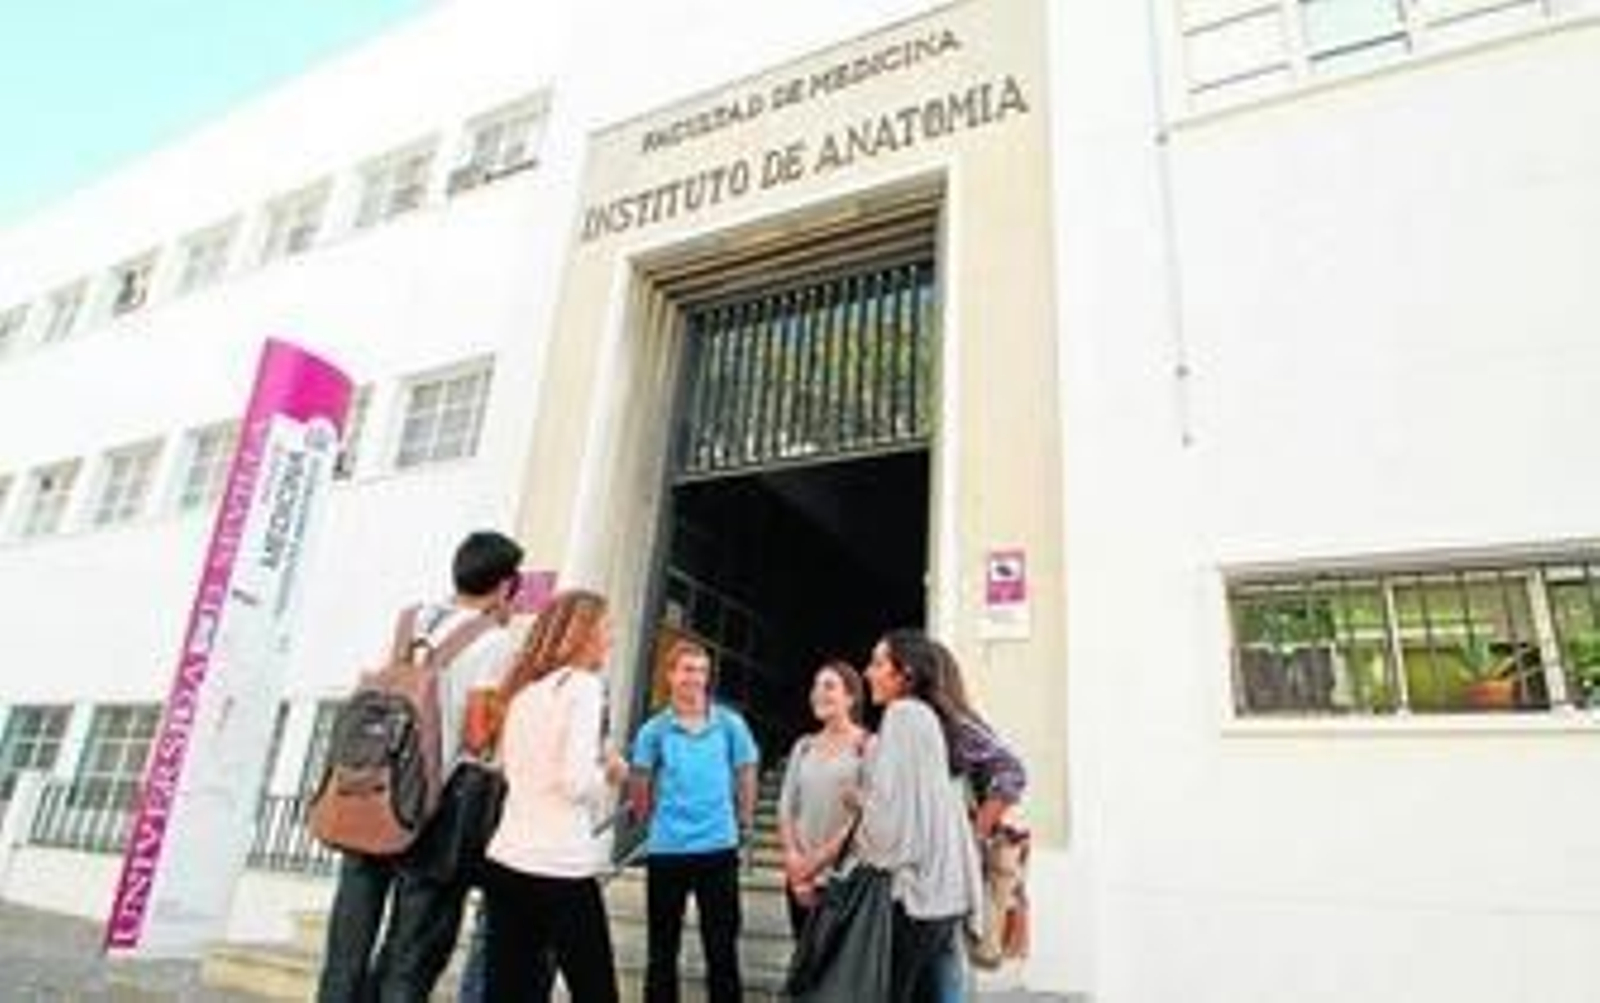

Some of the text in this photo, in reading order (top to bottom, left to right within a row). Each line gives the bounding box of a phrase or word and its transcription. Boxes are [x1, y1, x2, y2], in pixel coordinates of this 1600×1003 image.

[771, 78, 805, 109] DE
[809, 28, 962, 98] MEDICINA
[580, 160, 749, 240] INSTITUTO
[760, 143, 807, 189] DE
